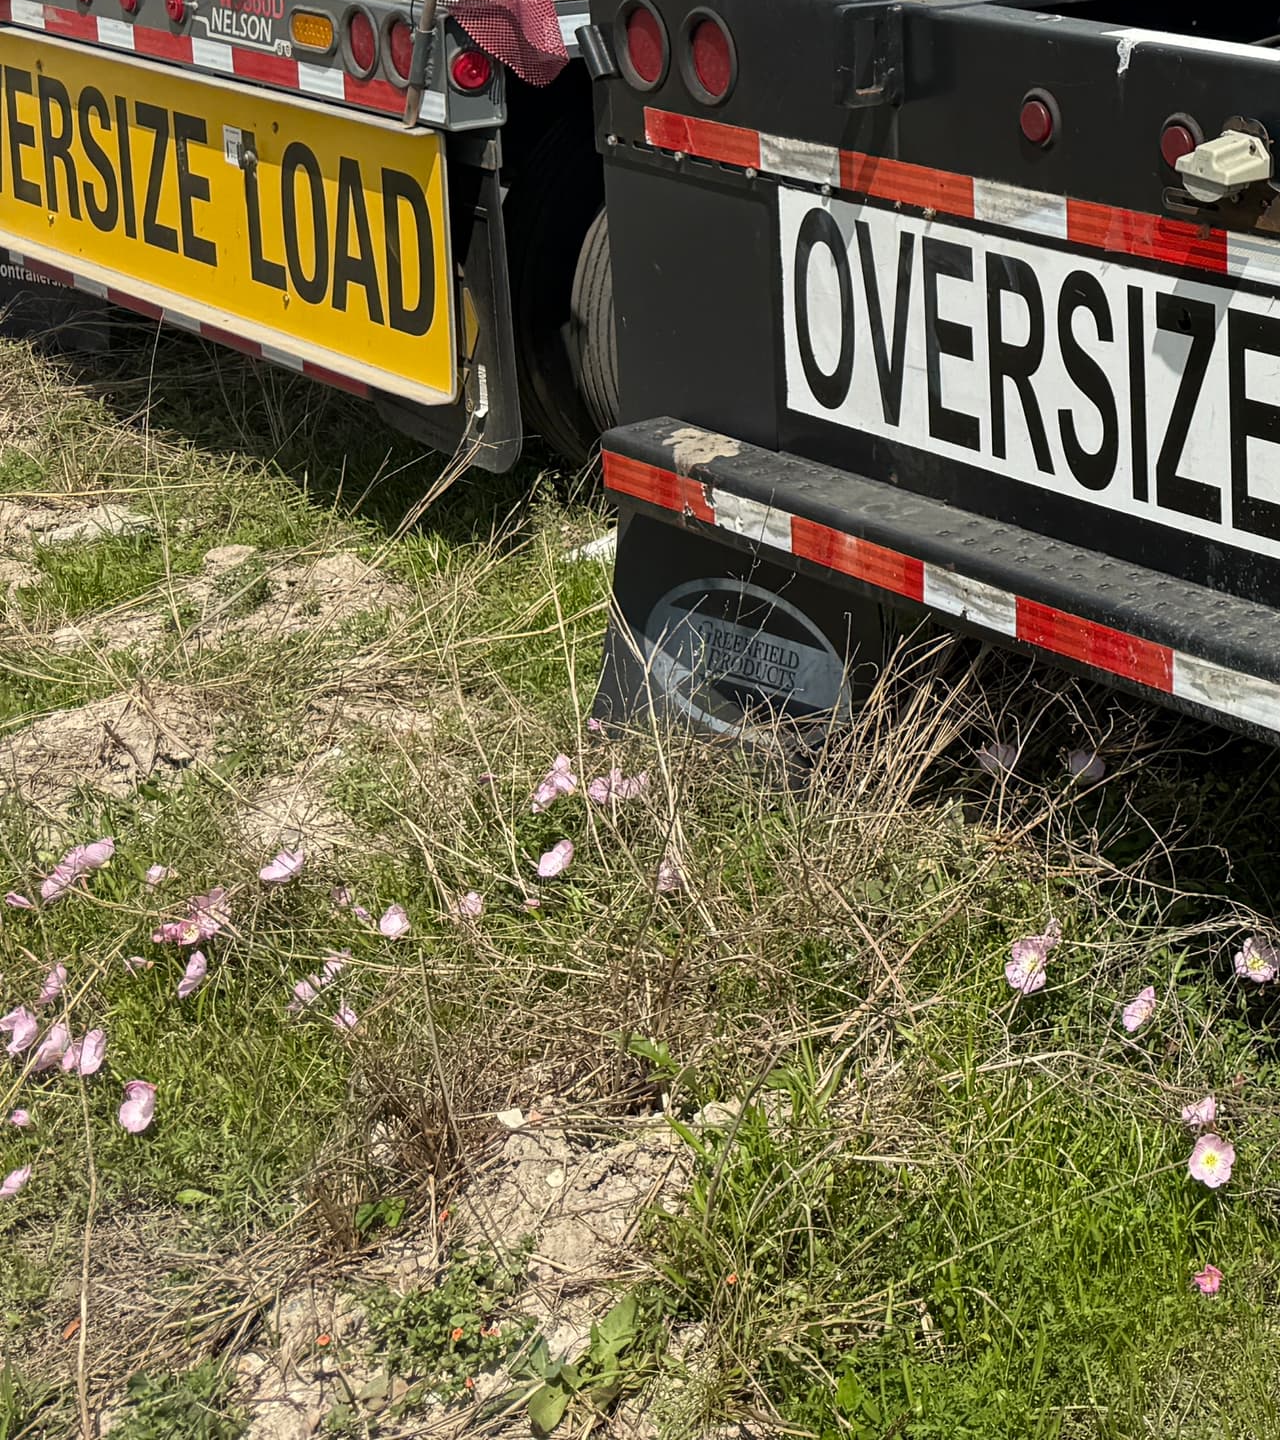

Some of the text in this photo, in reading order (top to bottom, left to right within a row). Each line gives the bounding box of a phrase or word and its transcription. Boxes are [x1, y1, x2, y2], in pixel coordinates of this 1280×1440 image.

[211, 6, 272, 43] NELSON
[0, 66, 436, 337] ERSIZE LOAD
[698, 620, 800, 669] GREENFIELD
[707, 648, 797, 690] PRODUCTS
